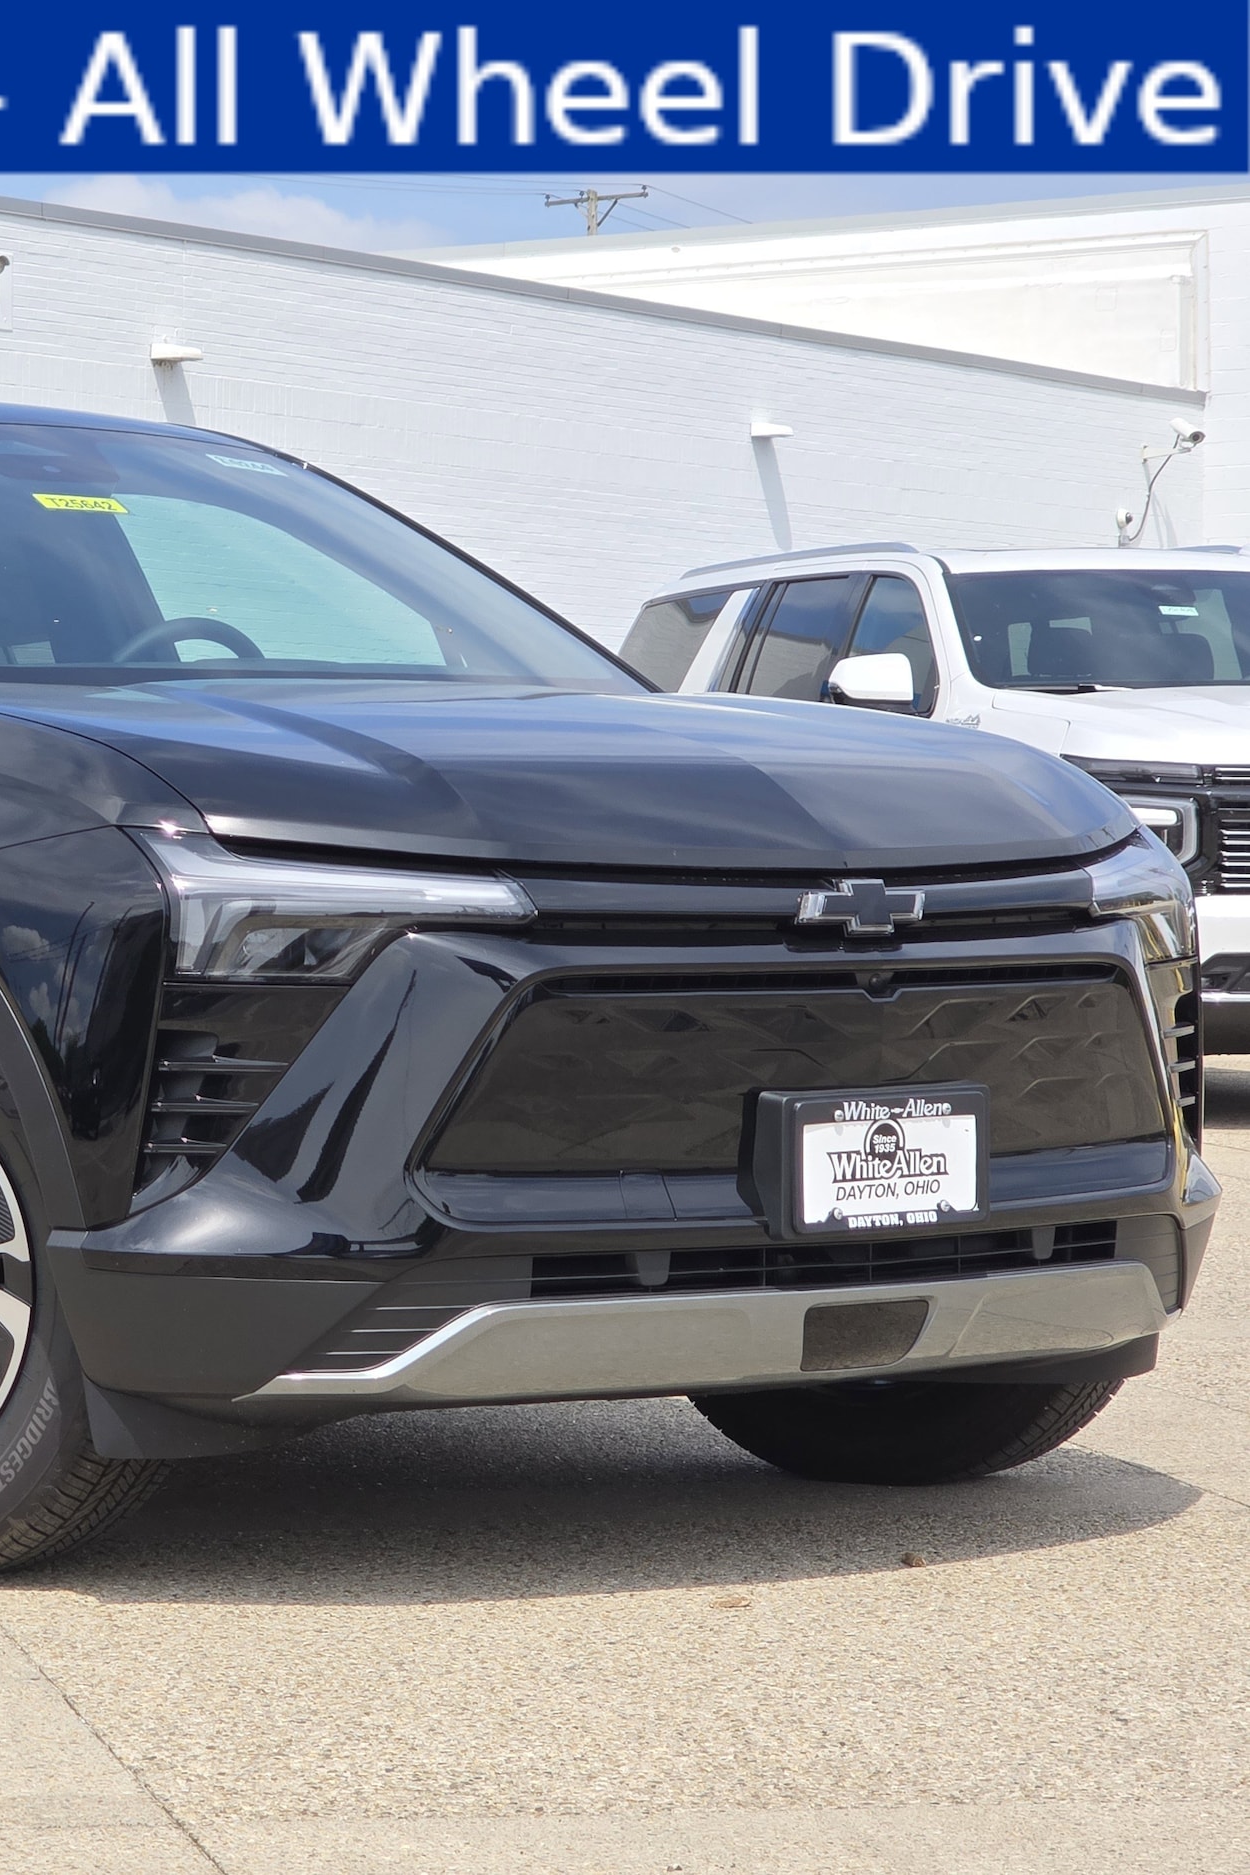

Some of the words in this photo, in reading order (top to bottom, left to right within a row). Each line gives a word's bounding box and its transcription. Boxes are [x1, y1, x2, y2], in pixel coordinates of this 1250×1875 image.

[872, 1134, 897, 1144] Since
[874, 1143, 896, 1153] 1935
[836, 1183, 899, 1200] DAYTON,
[904, 1179, 941, 1195] OHIO
[848, 1213, 903, 1228] DAYTON,
[906, 1211, 938, 1224] OHIO
